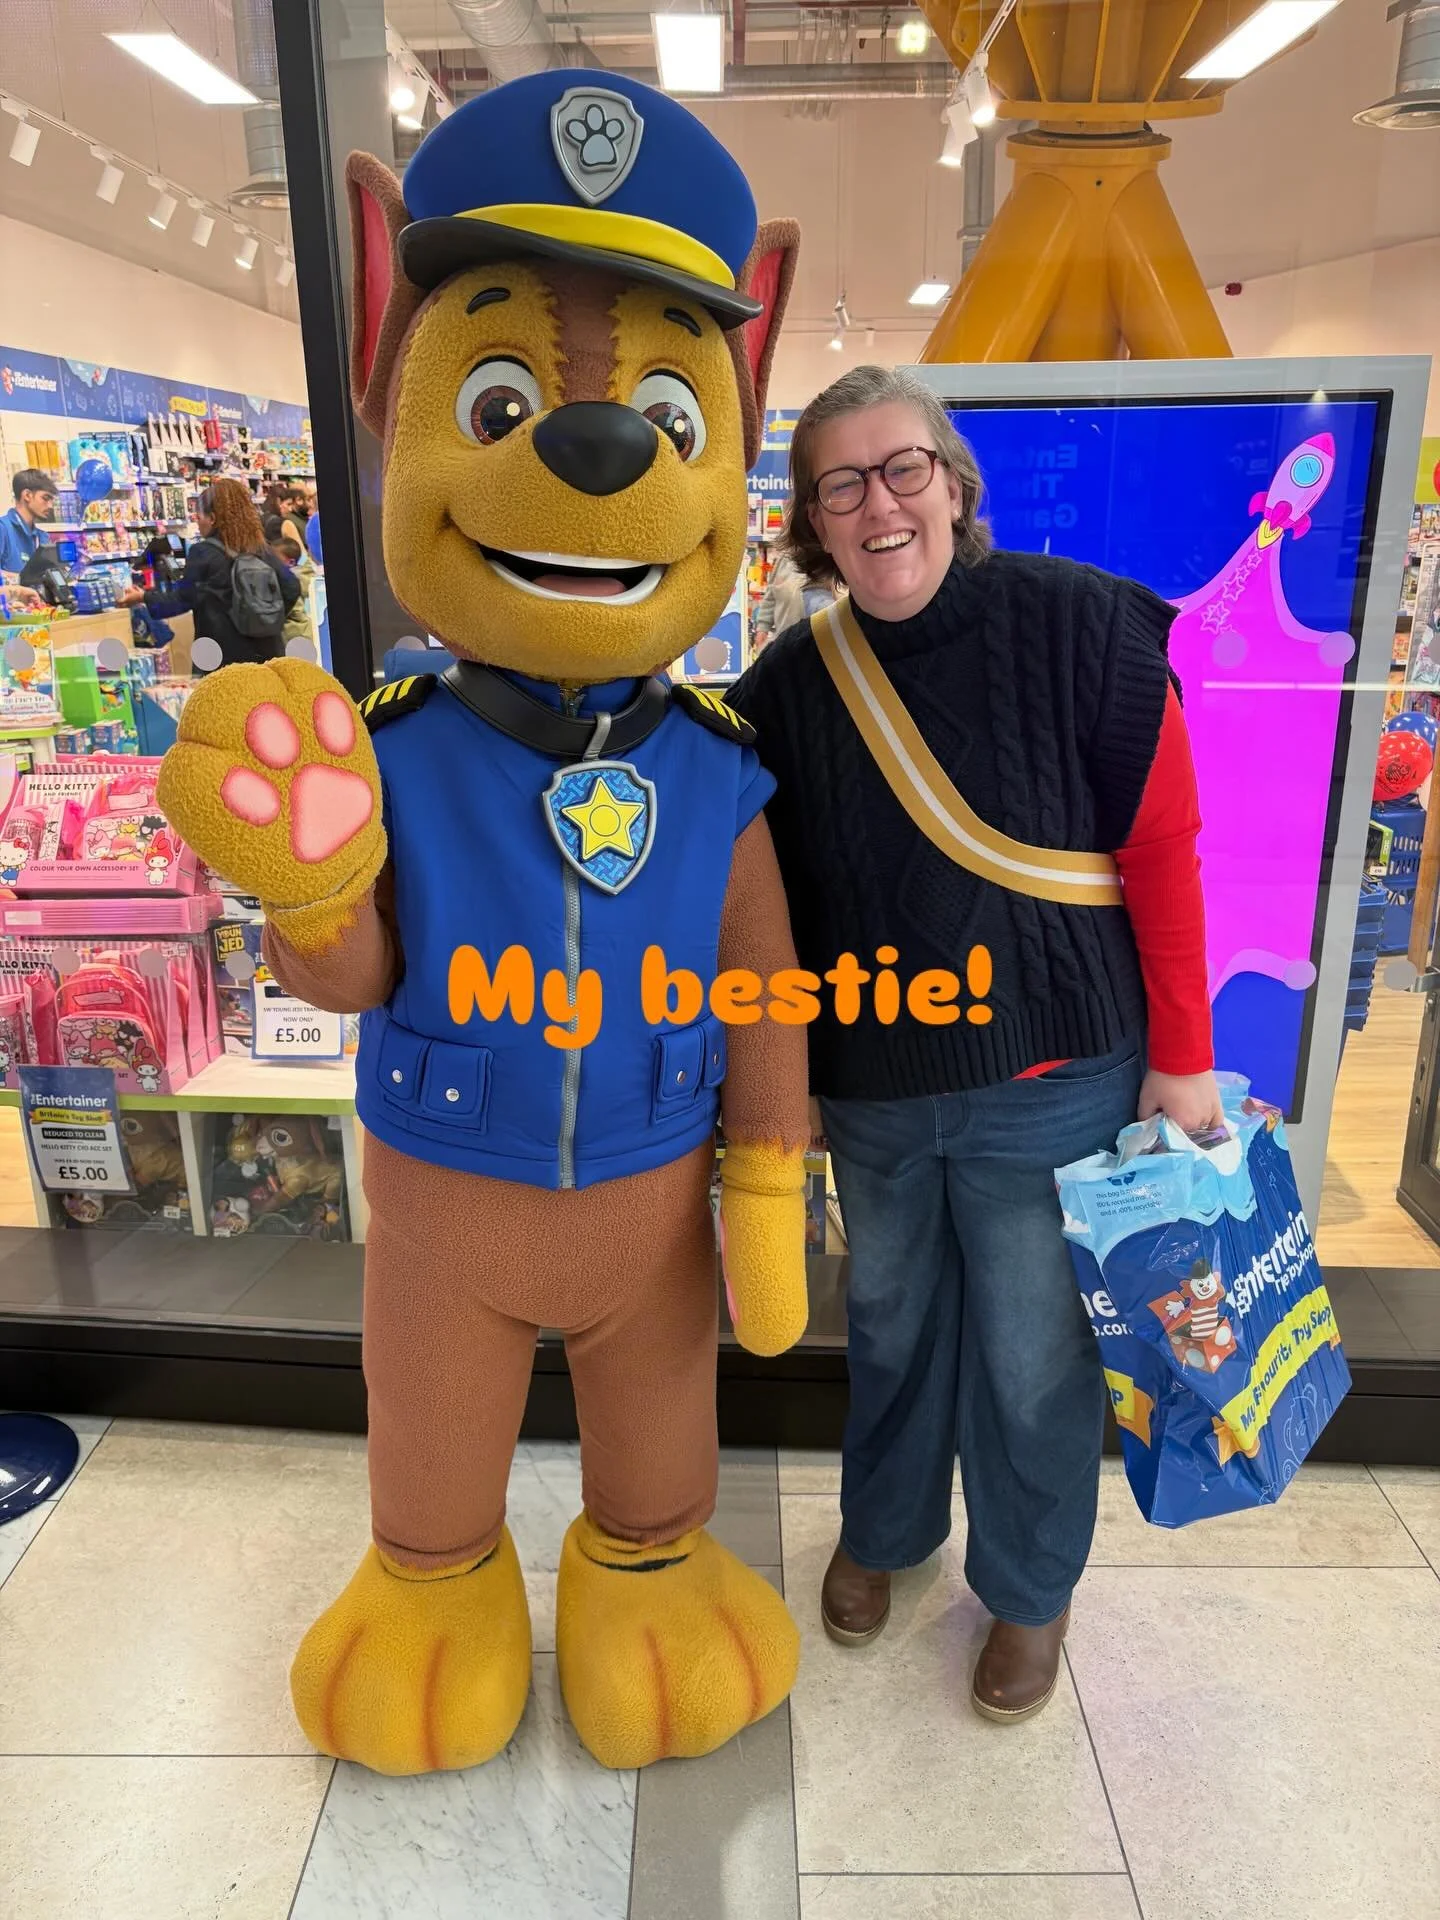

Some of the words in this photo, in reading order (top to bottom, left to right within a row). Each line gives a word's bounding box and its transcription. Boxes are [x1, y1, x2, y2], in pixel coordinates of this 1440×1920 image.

[29, 783, 61, 791] HELLO
[64, 783, 97, 791] KITTY
[21, 961, 53, 970] KITTY
[275, 1028, 321, 1043] £5.00
[36, 1093, 108, 1107] Entertainer
[58, 1166, 108, 1181] £5.00
[1111, 1197, 1135, 1206] recycled
[1240, 1405, 1256, 1432] My
